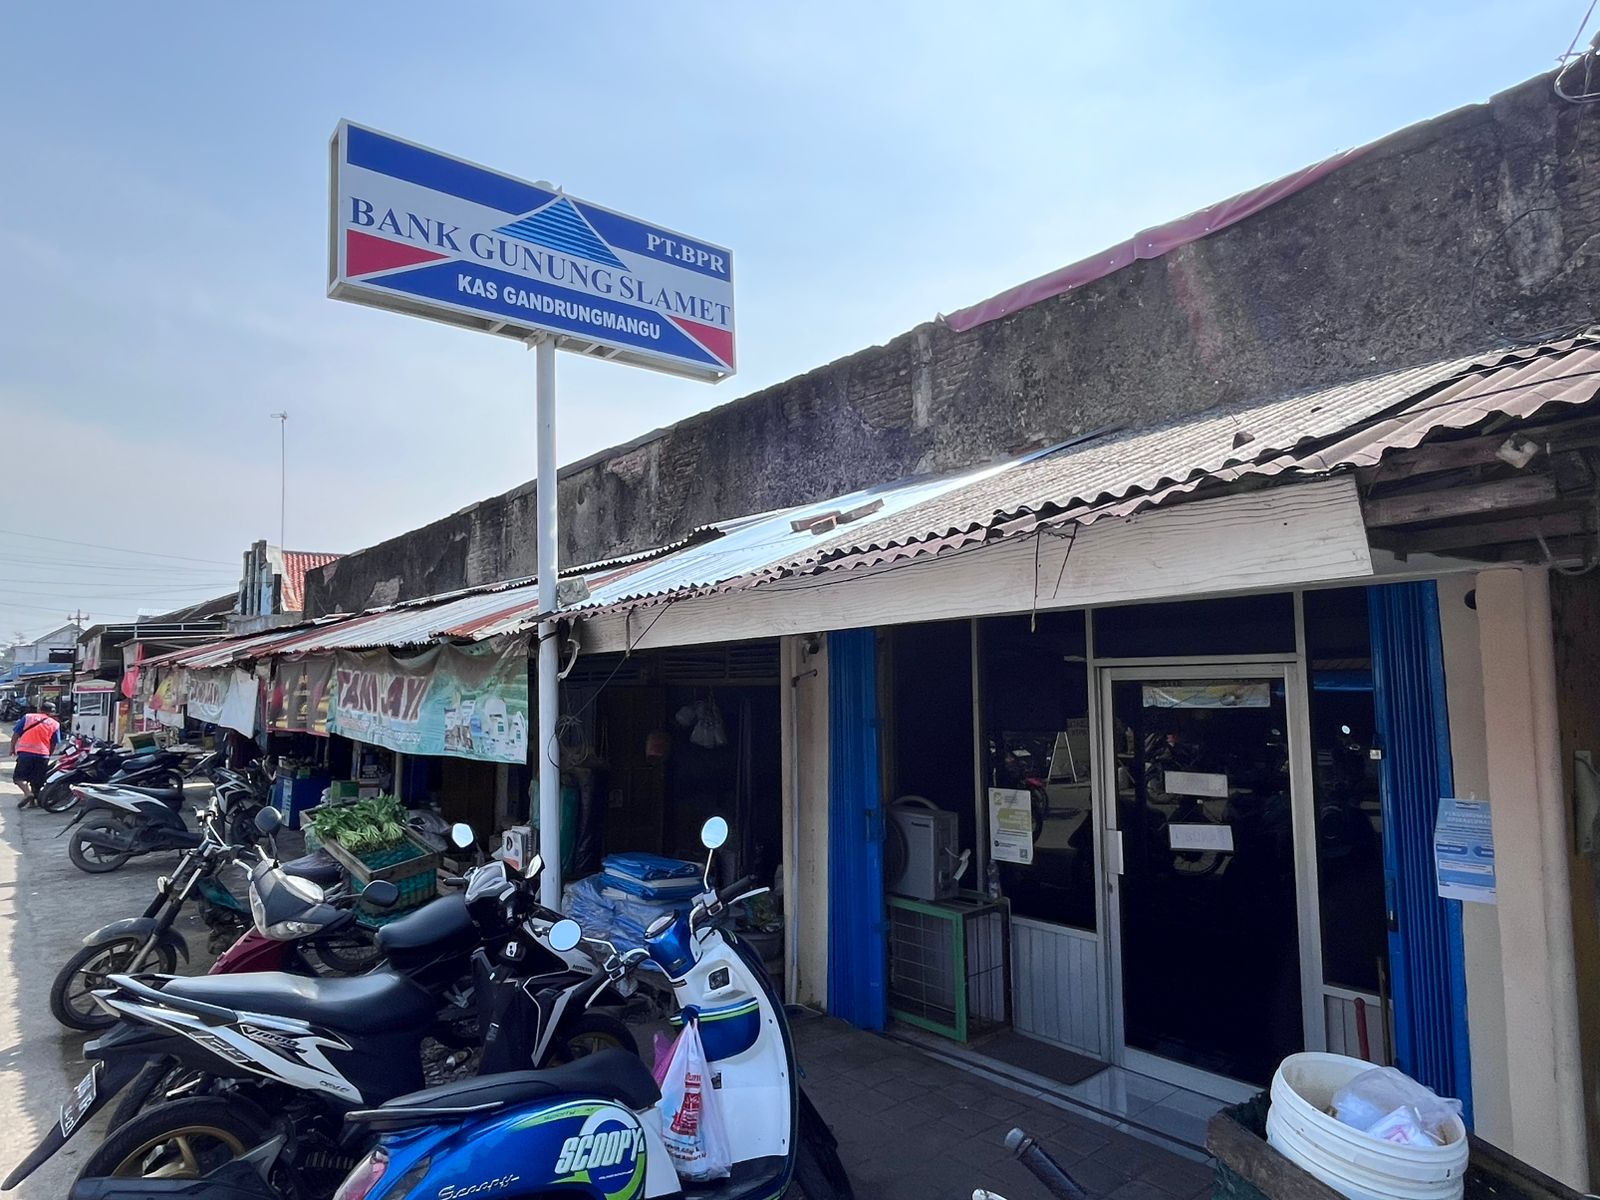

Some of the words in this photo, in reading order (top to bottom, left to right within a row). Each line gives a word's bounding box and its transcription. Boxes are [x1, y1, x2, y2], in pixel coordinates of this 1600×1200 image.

[350, 197, 461, 252] BANK
[469, 233, 612, 294] GUNUNG
[620, 275, 730, 326] SLAMET
[646, 233, 726, 274] PT.BPR
[458, 274, 498, 299] KAS
[503, 286, 660, 340] GANDRUNGMANGU
[554, 1127, 643, 1175] SCOOPY
